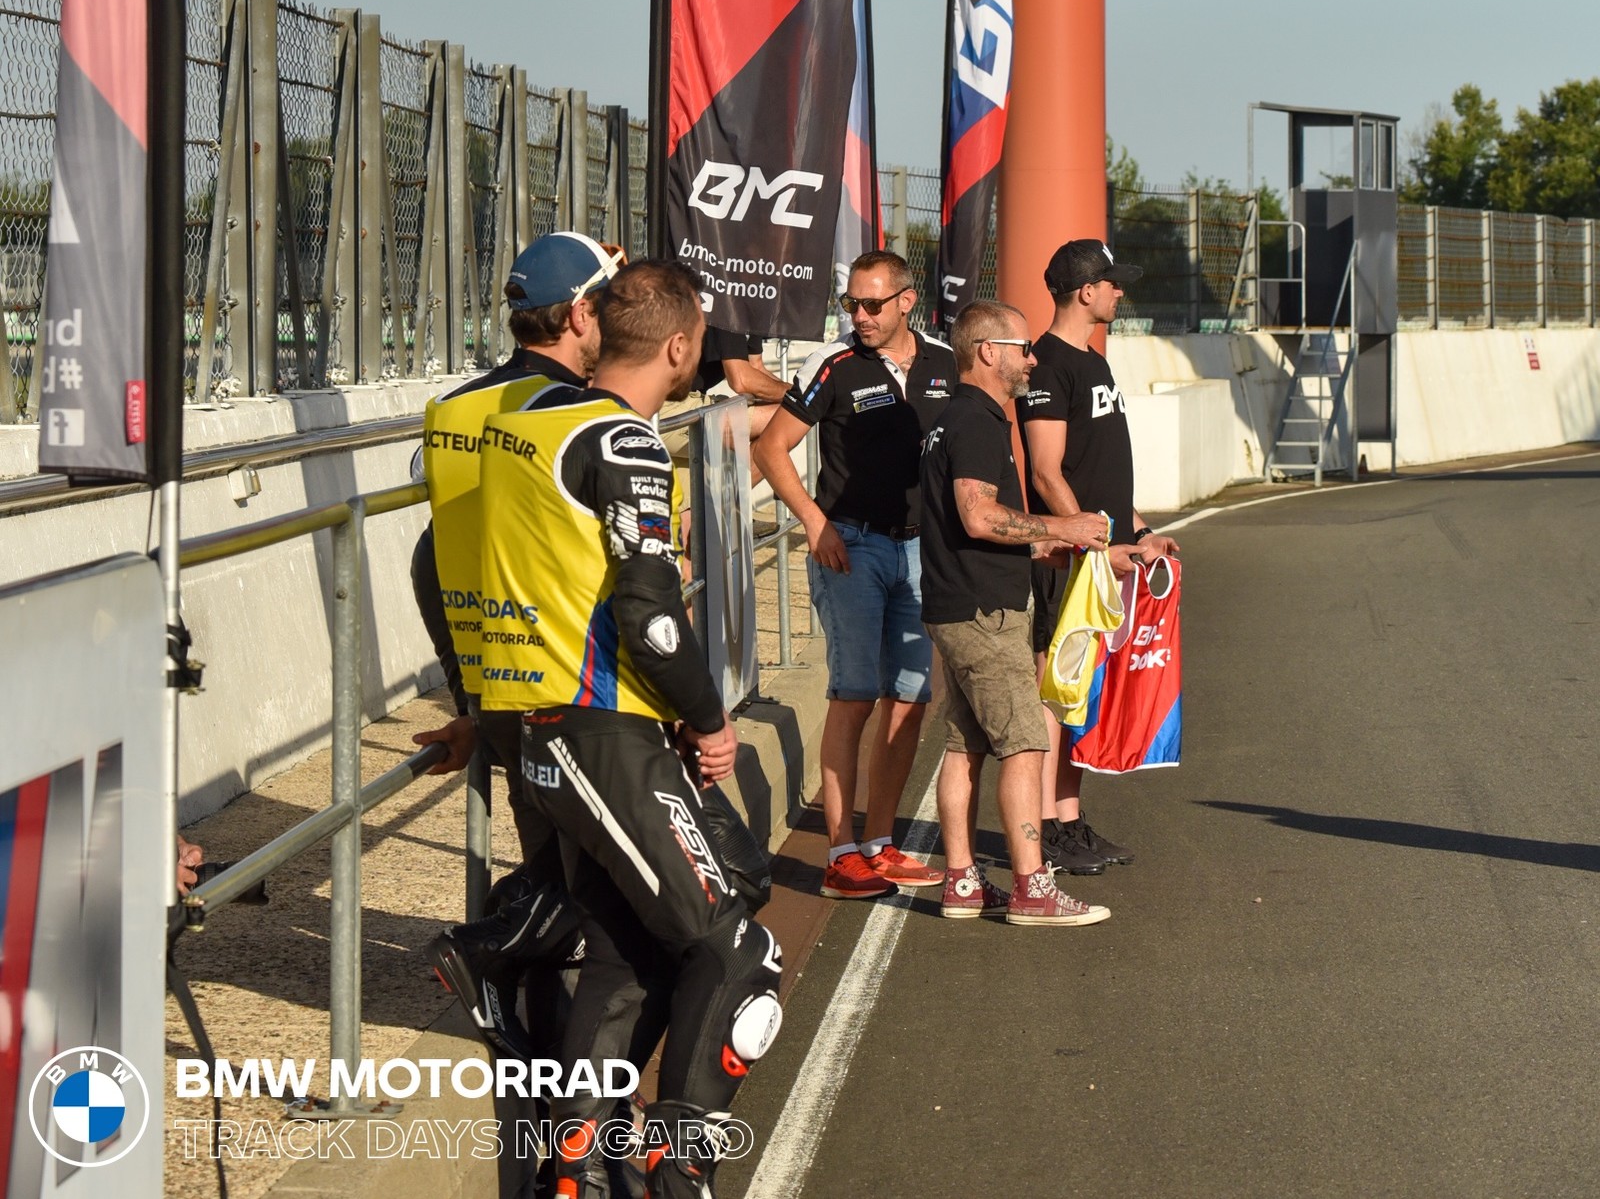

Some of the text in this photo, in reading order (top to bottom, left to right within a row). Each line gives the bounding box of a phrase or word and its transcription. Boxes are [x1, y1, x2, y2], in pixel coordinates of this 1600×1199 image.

[688, 159, 824, 229] BMC
[678, 238, 813, 280] bmc-moto.com
[684, 264, 777, 300] mcmoto
[654, 790, 728, 895] RST
